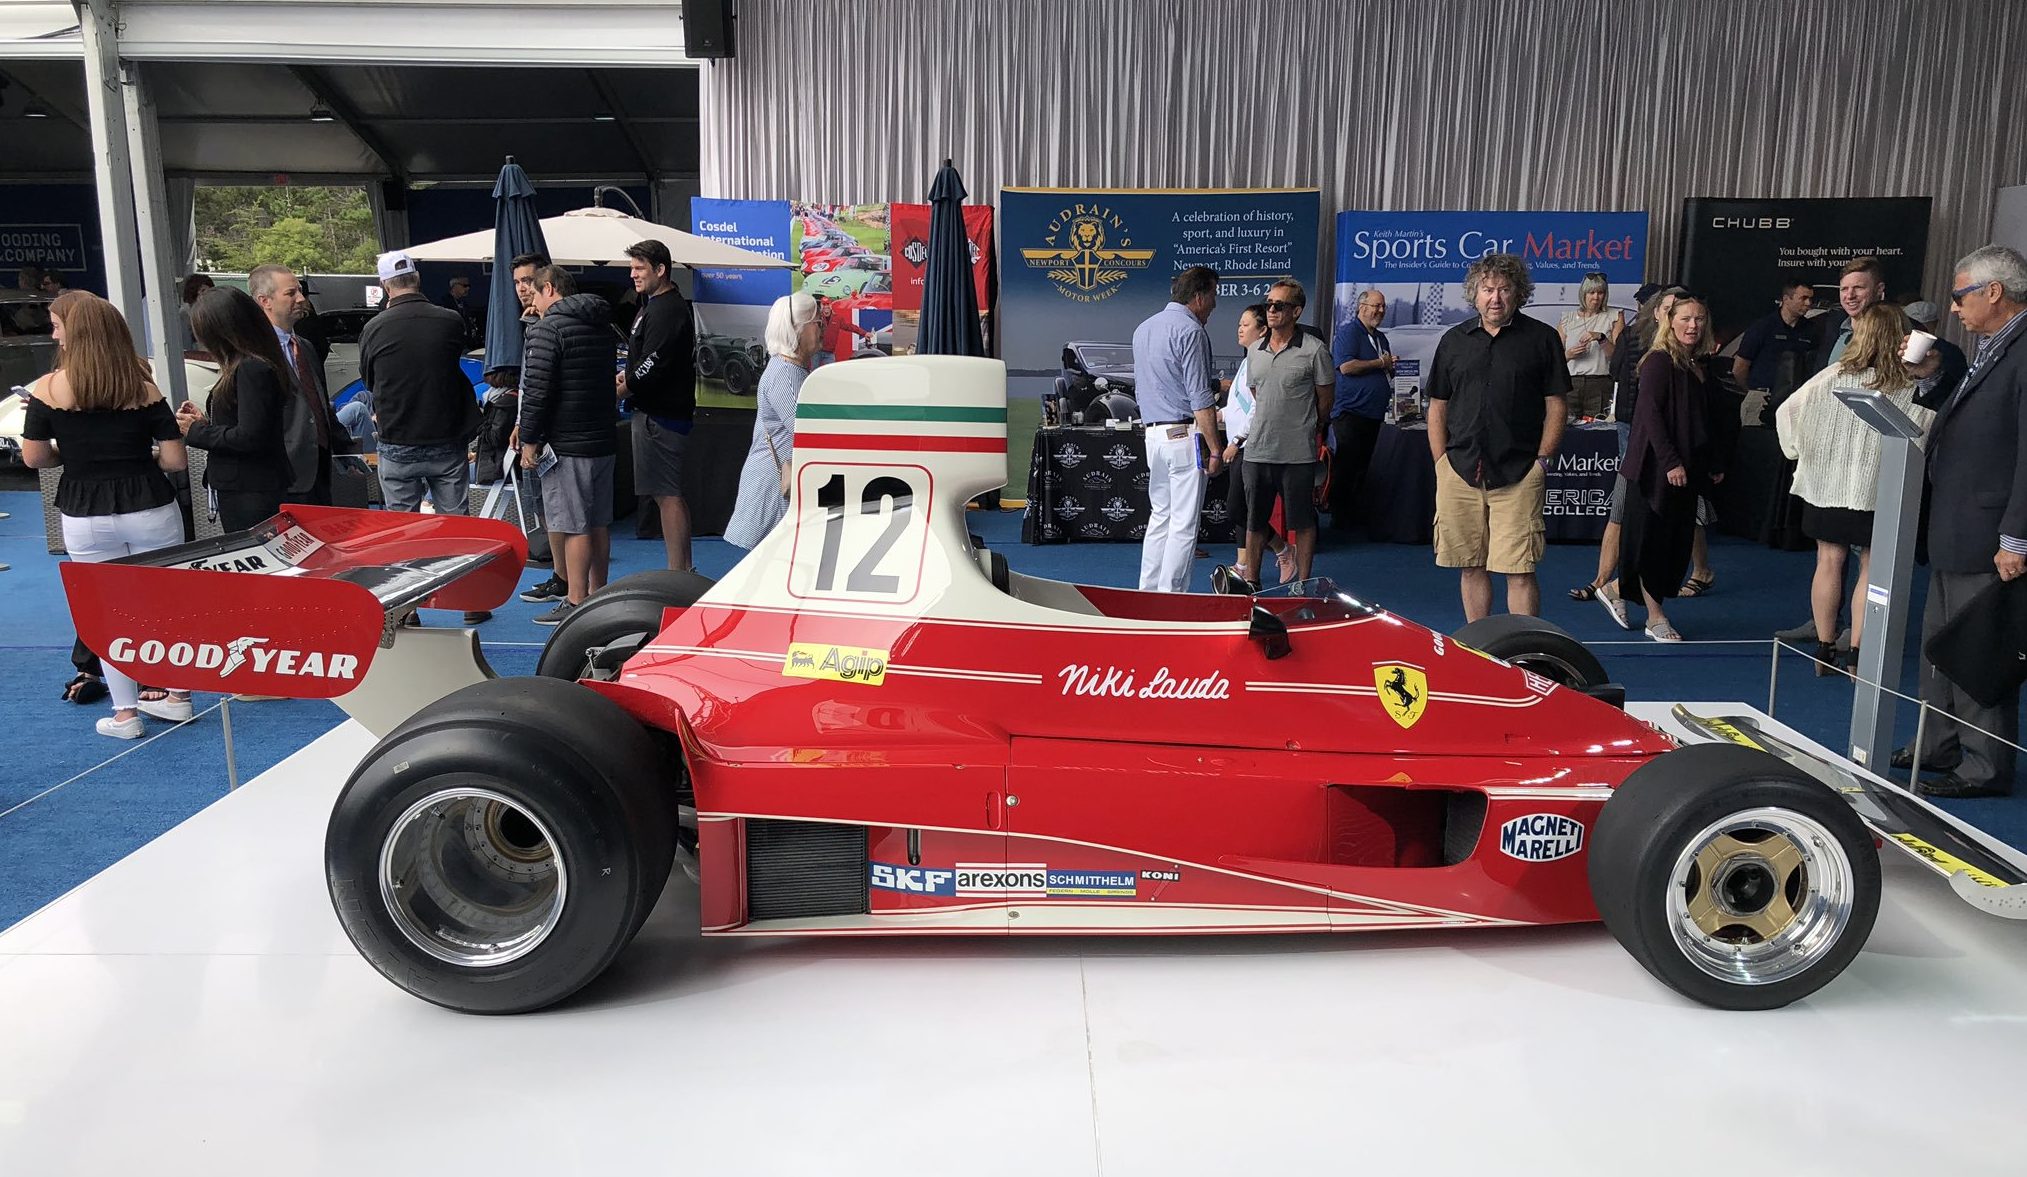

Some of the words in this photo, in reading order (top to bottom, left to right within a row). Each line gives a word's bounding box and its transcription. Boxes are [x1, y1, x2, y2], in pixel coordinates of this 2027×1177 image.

[1171, 212, 1180, 222] A
[1183, 211, 1240, 222] celebration
[1243, 210, 1255, 221] of
[1256, 210, 1294, 223] history,
[1712, 217, 1791, 229] CHUBB
[699, 220, 738, 232] Cosdel
[1, 233, 62, 247] OODING
[1182, 228, 1213, 241] sport,
[1215, 227, 1235, 238] and
[1237, 227, 1272, 240] luxury
[1274, 226, 1284, 237] in
[1373, 230, 1393, 238] Keith
[1395, 230, 1425, 238] Martin's
[1229, 243, 1252, 254] First
[1353, 231, 1447, 268] Sports
[1458, 231, 1513, 259] Car
[1522, 229, 1633, 260] Market
[1779, 246, 1796, 256] You
[1796, 246, 1828, 257] bought
[1830, 246, 1851, 256] with
[1852, 247, 1875, 257] your
[1876, 246, 1904, 256] heart.
[1029, 259, 1070, 267] NEWPORT
[1103, 259, 1147, 267] CONCOURS
[1224, 259, 1258, 270] Rhode
[1260, 258, 1291, 270] Island
[1384, 261, 1398, 269] The
[1428, 261, 1451, 269] Guide
[1562, 261, 1576, 269] and
[1577, 261, 1601, 269] Trends
[1777, 258, 1805, 267] Insure
[1806, 258, 1826, 267] with
[1056, 285, 1090, 303] MOTOR
[1093, 286, 1119, 302] WEEK
[1240, 283, 1261, 296] 3-6
[1558, 452, 1621, 471] Market
[815, 474, 914, 594] 12
[202, 555, 268, 573] YEAR
[819, 647, 884, 680] Agip
[1138, 666, 1230, 699] Lauda
[871, 864, 953, 892] SKF
[957, 871, 1046, 888] arexons
[1049, 875, 1134, 886] SCHMITTHELM
[1141, 871, 1179, 880] KONI
